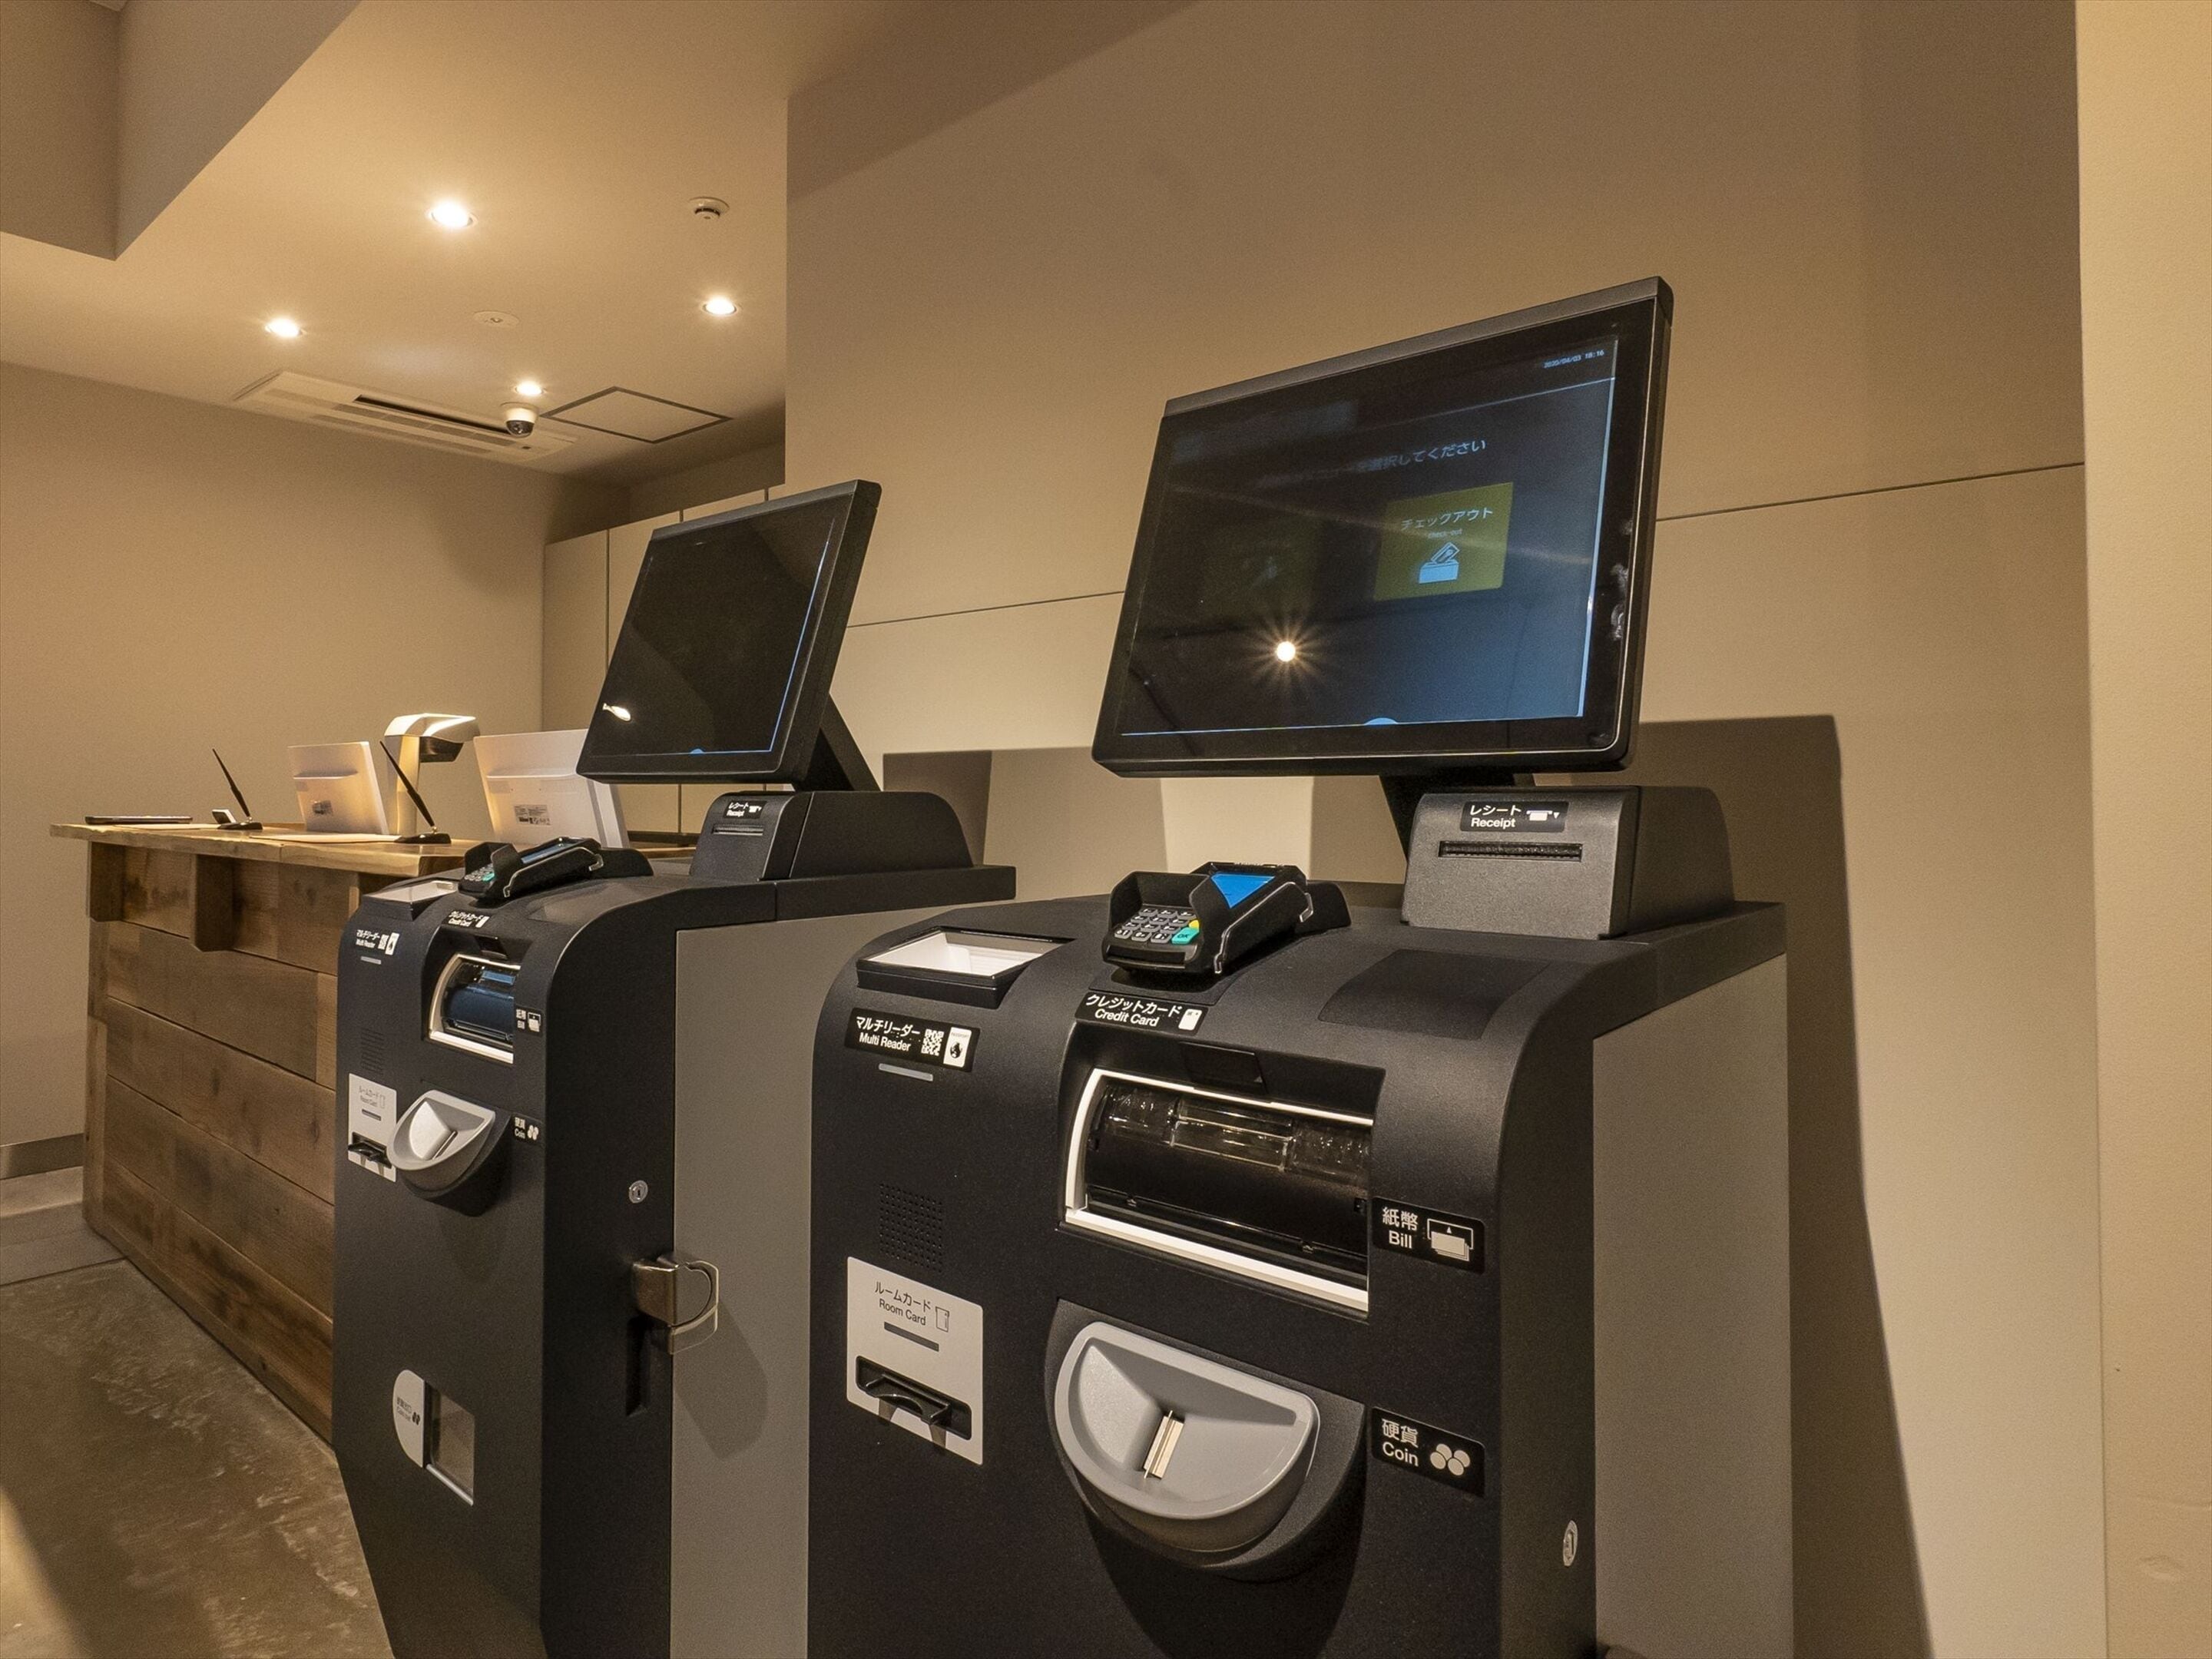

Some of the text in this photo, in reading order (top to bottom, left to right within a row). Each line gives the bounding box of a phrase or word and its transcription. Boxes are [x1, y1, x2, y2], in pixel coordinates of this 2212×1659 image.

[1400, 507, 1493, 531] チェックアウト
[1469, 805, 1522, 816] レシート
[1471, 817, 1516, 830] Receipt
[1086, 994, 1183, 1017] クレジットカード
[856, 1016, 920, 1037] マルチリーダー
[1094, 1008, 1160, 1027] Credit Card
[859, 1032, 911, 1051] Multi Reader
[1382, 1207, 1419, 1231] 紙幣
[1389, 1230, 1412, 1249] Bill
[875, 1281, 932, 1313] ルームカード
[879, 1298, 926, 1326] Room Card
[1382, 1418, 1419, 1449] 硬貨
[1382, 1442, 1419, 1467] Coin
